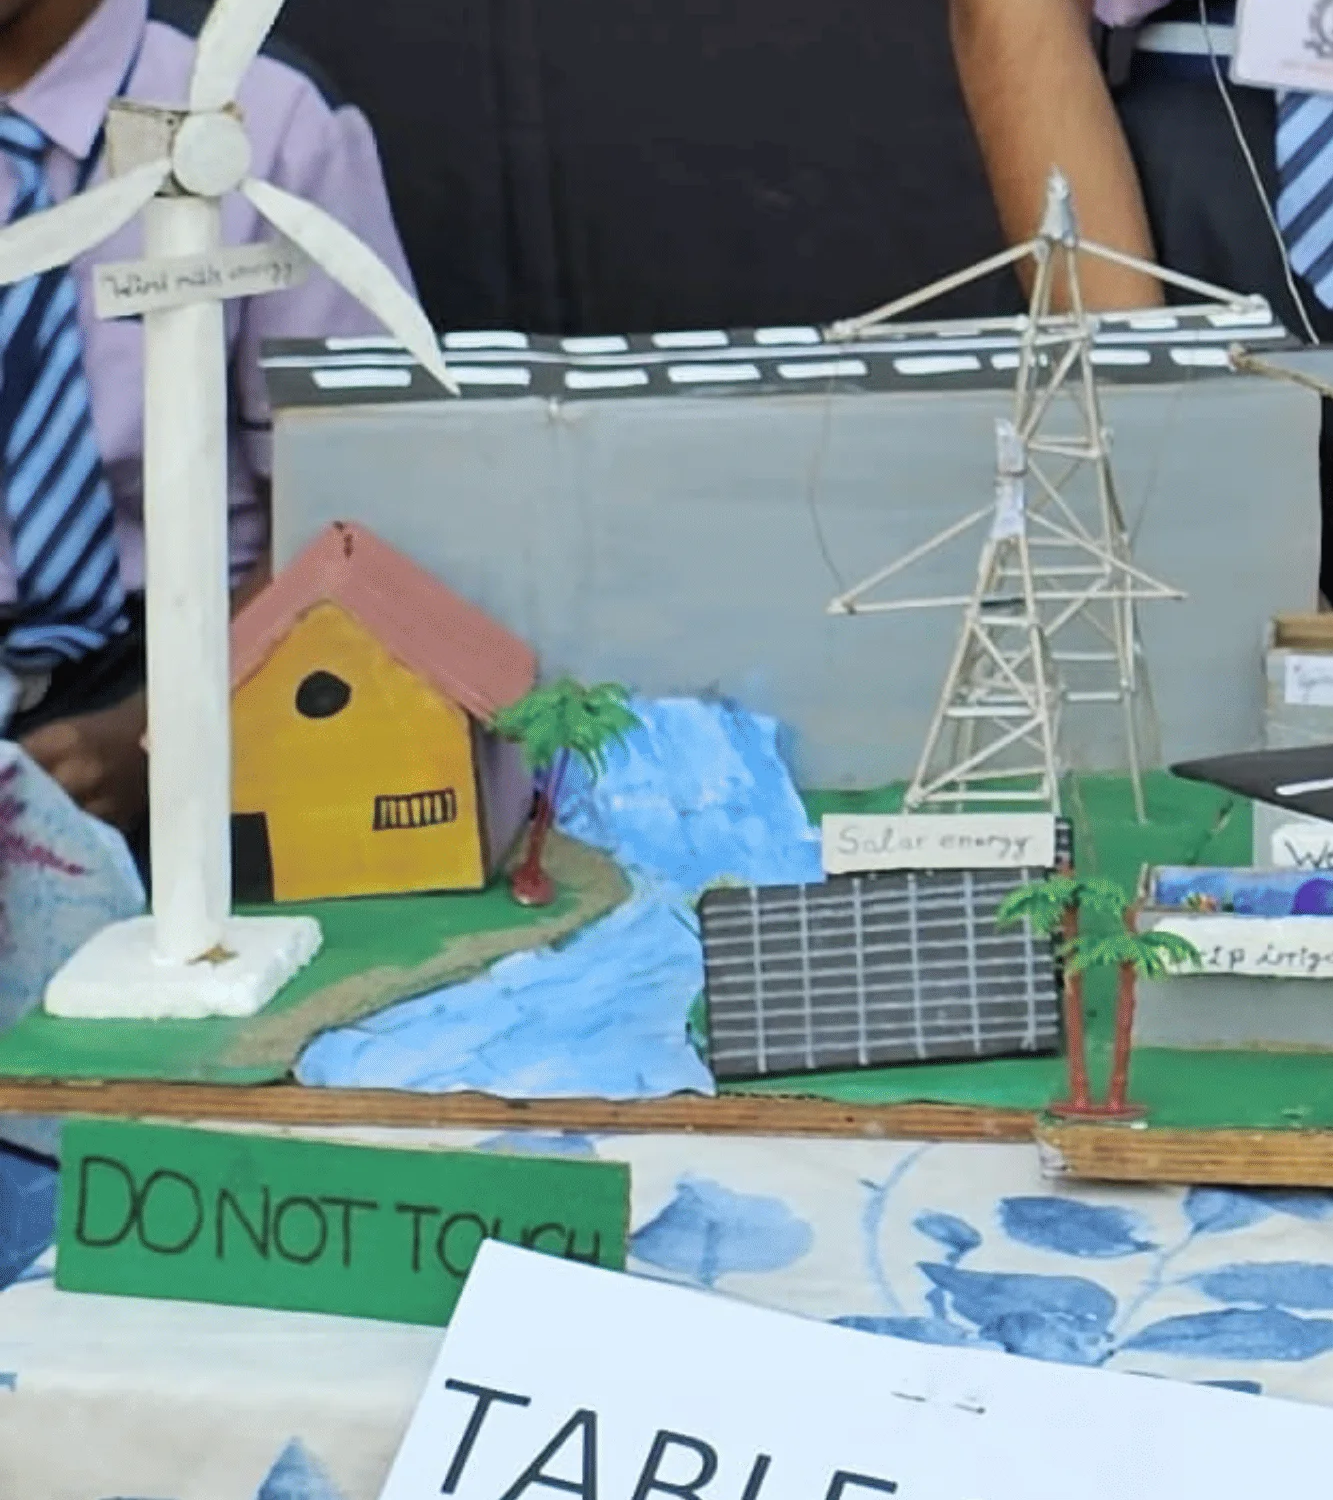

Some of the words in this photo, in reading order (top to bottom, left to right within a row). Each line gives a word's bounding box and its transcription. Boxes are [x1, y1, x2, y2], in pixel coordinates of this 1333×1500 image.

[836, 823, 926, 856] Solar
[75, 1154, 203, 1256] DO
[215, 1184, 378, 1270] NOT
[395, 1202, 601, 1281] TOCH
[440, 1378, 898, 1500] TAB
